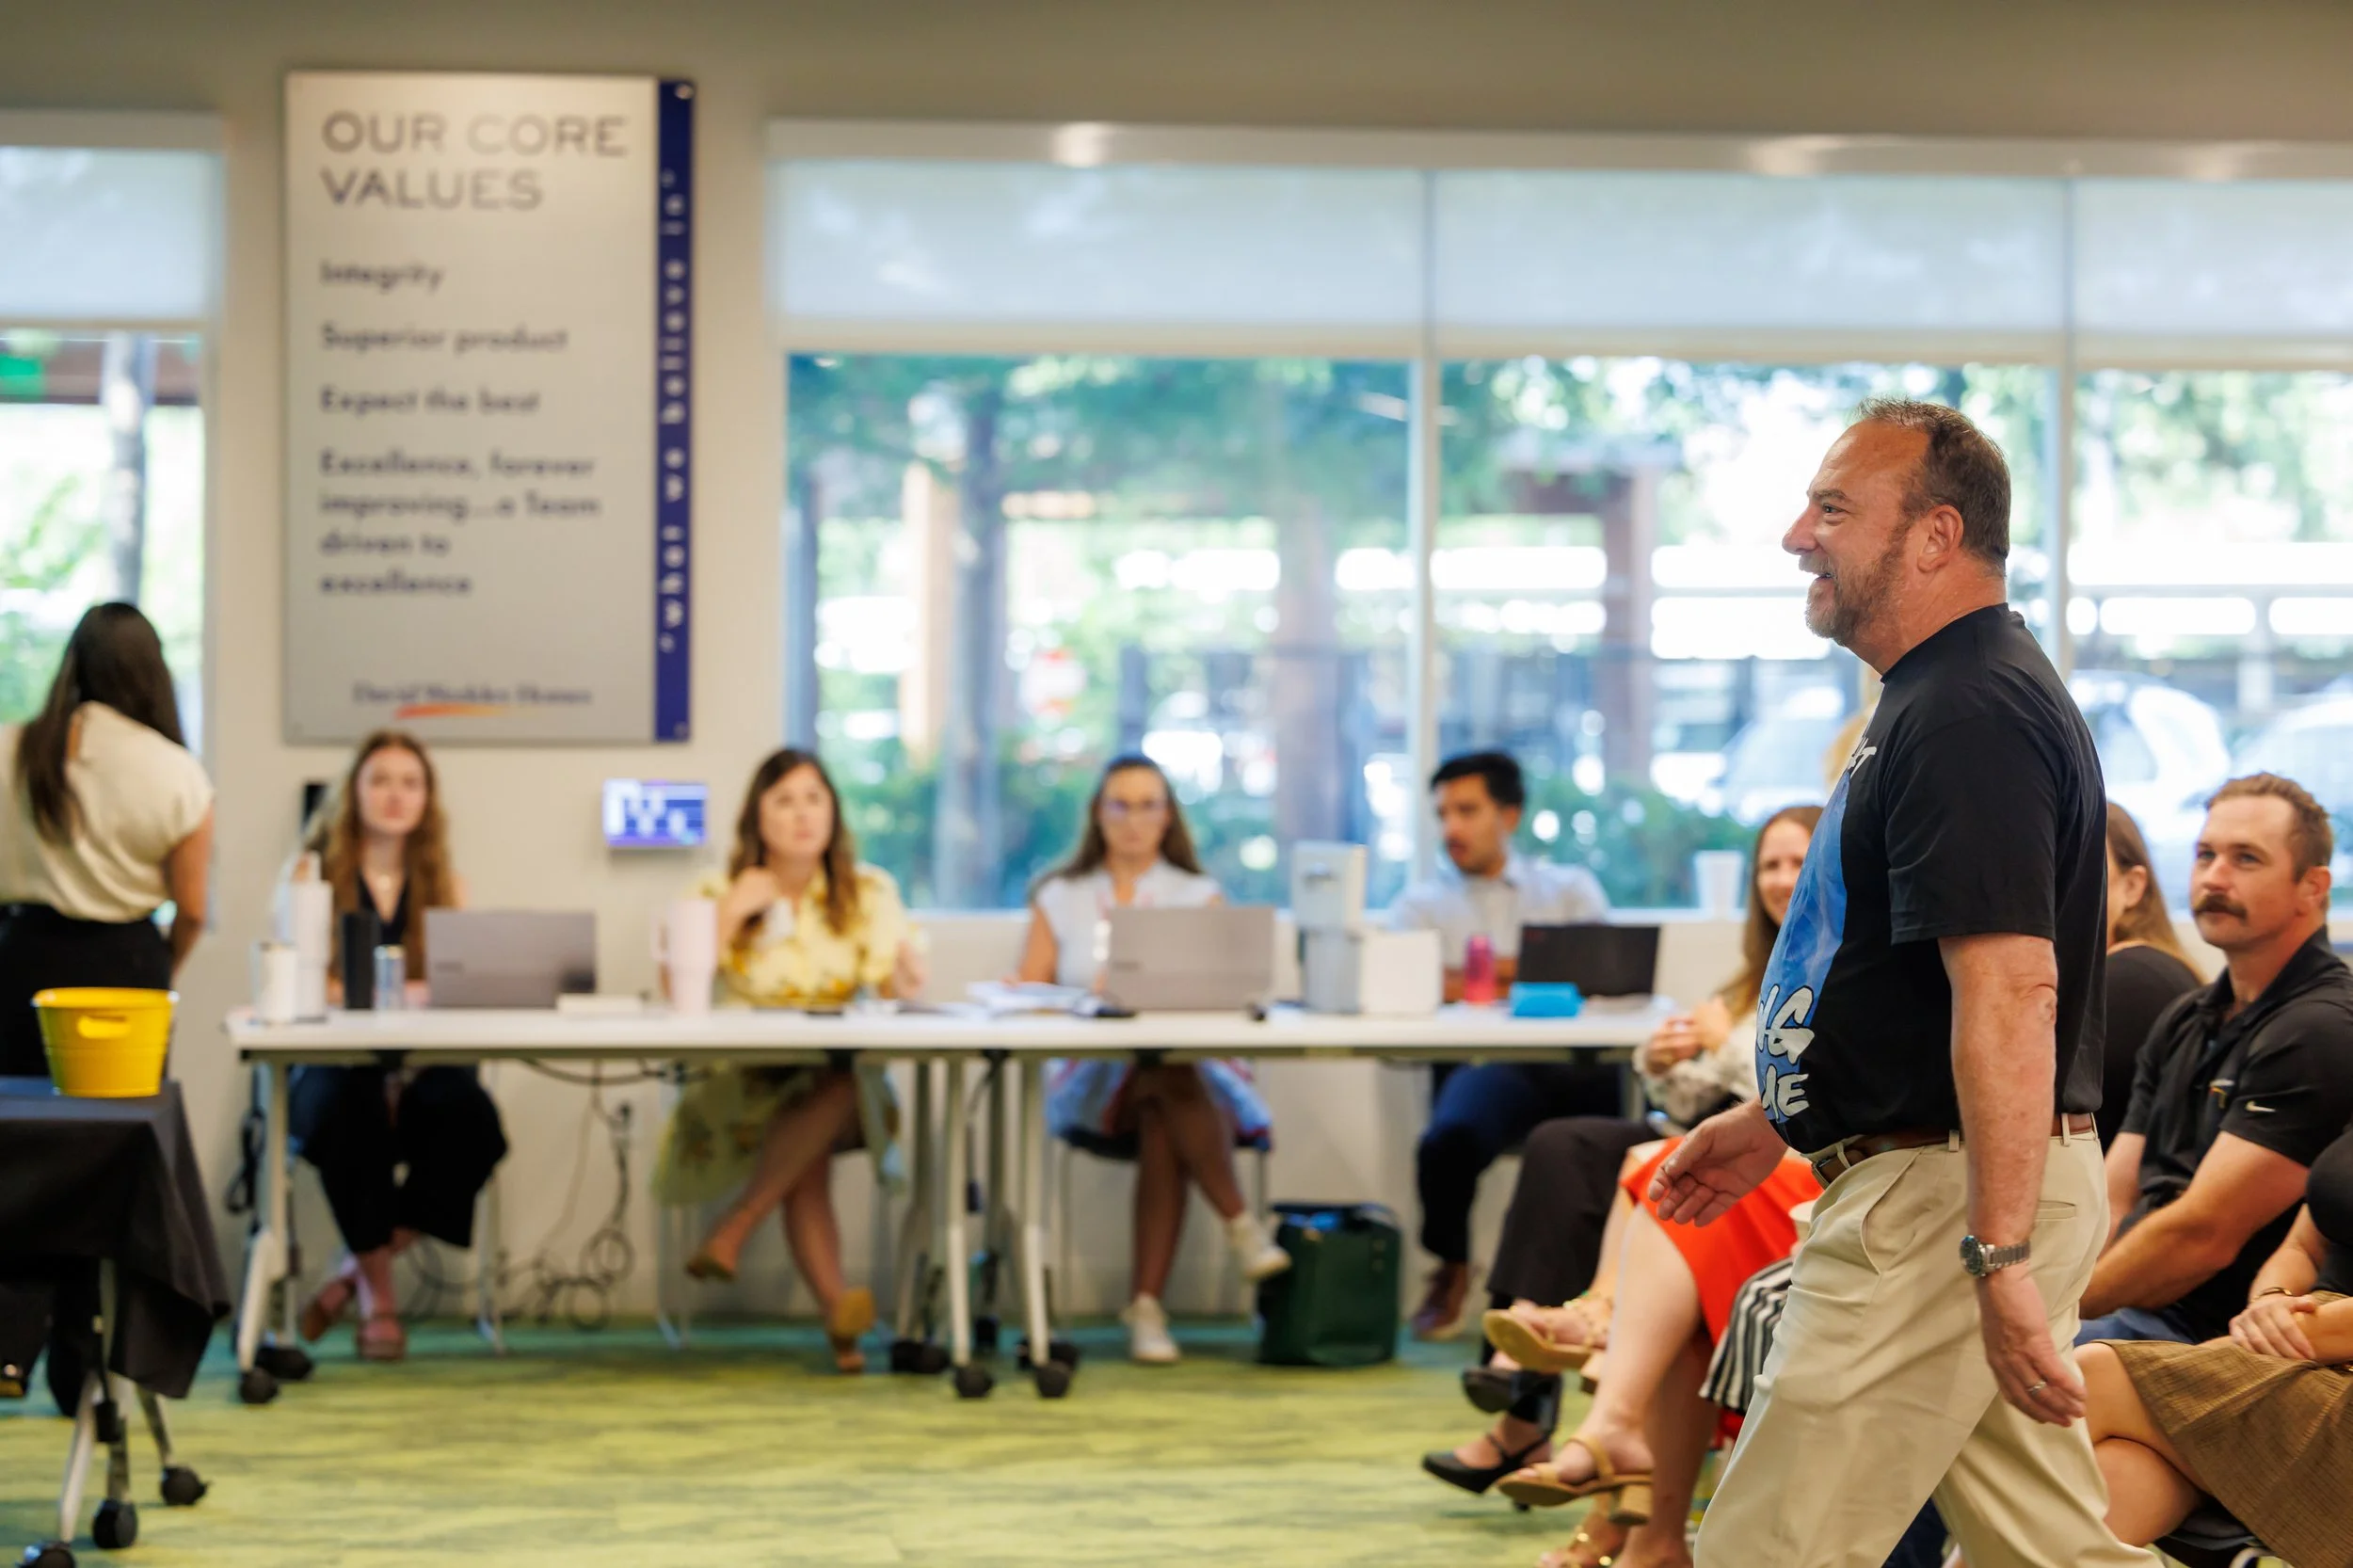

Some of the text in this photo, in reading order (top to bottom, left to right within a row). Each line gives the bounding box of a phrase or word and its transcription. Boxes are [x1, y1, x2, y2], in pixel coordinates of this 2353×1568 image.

[323, 111, 627, 156] OUR CORE
[320, 168, 541, 209] VALUES
[322, 262, 442, 292] Integrity
[323, 324, 567, 354] Superior product
[321, 386, 538, 415] Expect the best
[321, 449, 596, 477] Excellence, forever
[321, 532, 450, 555] driven to
[321, 569, 472, 595] excellence
